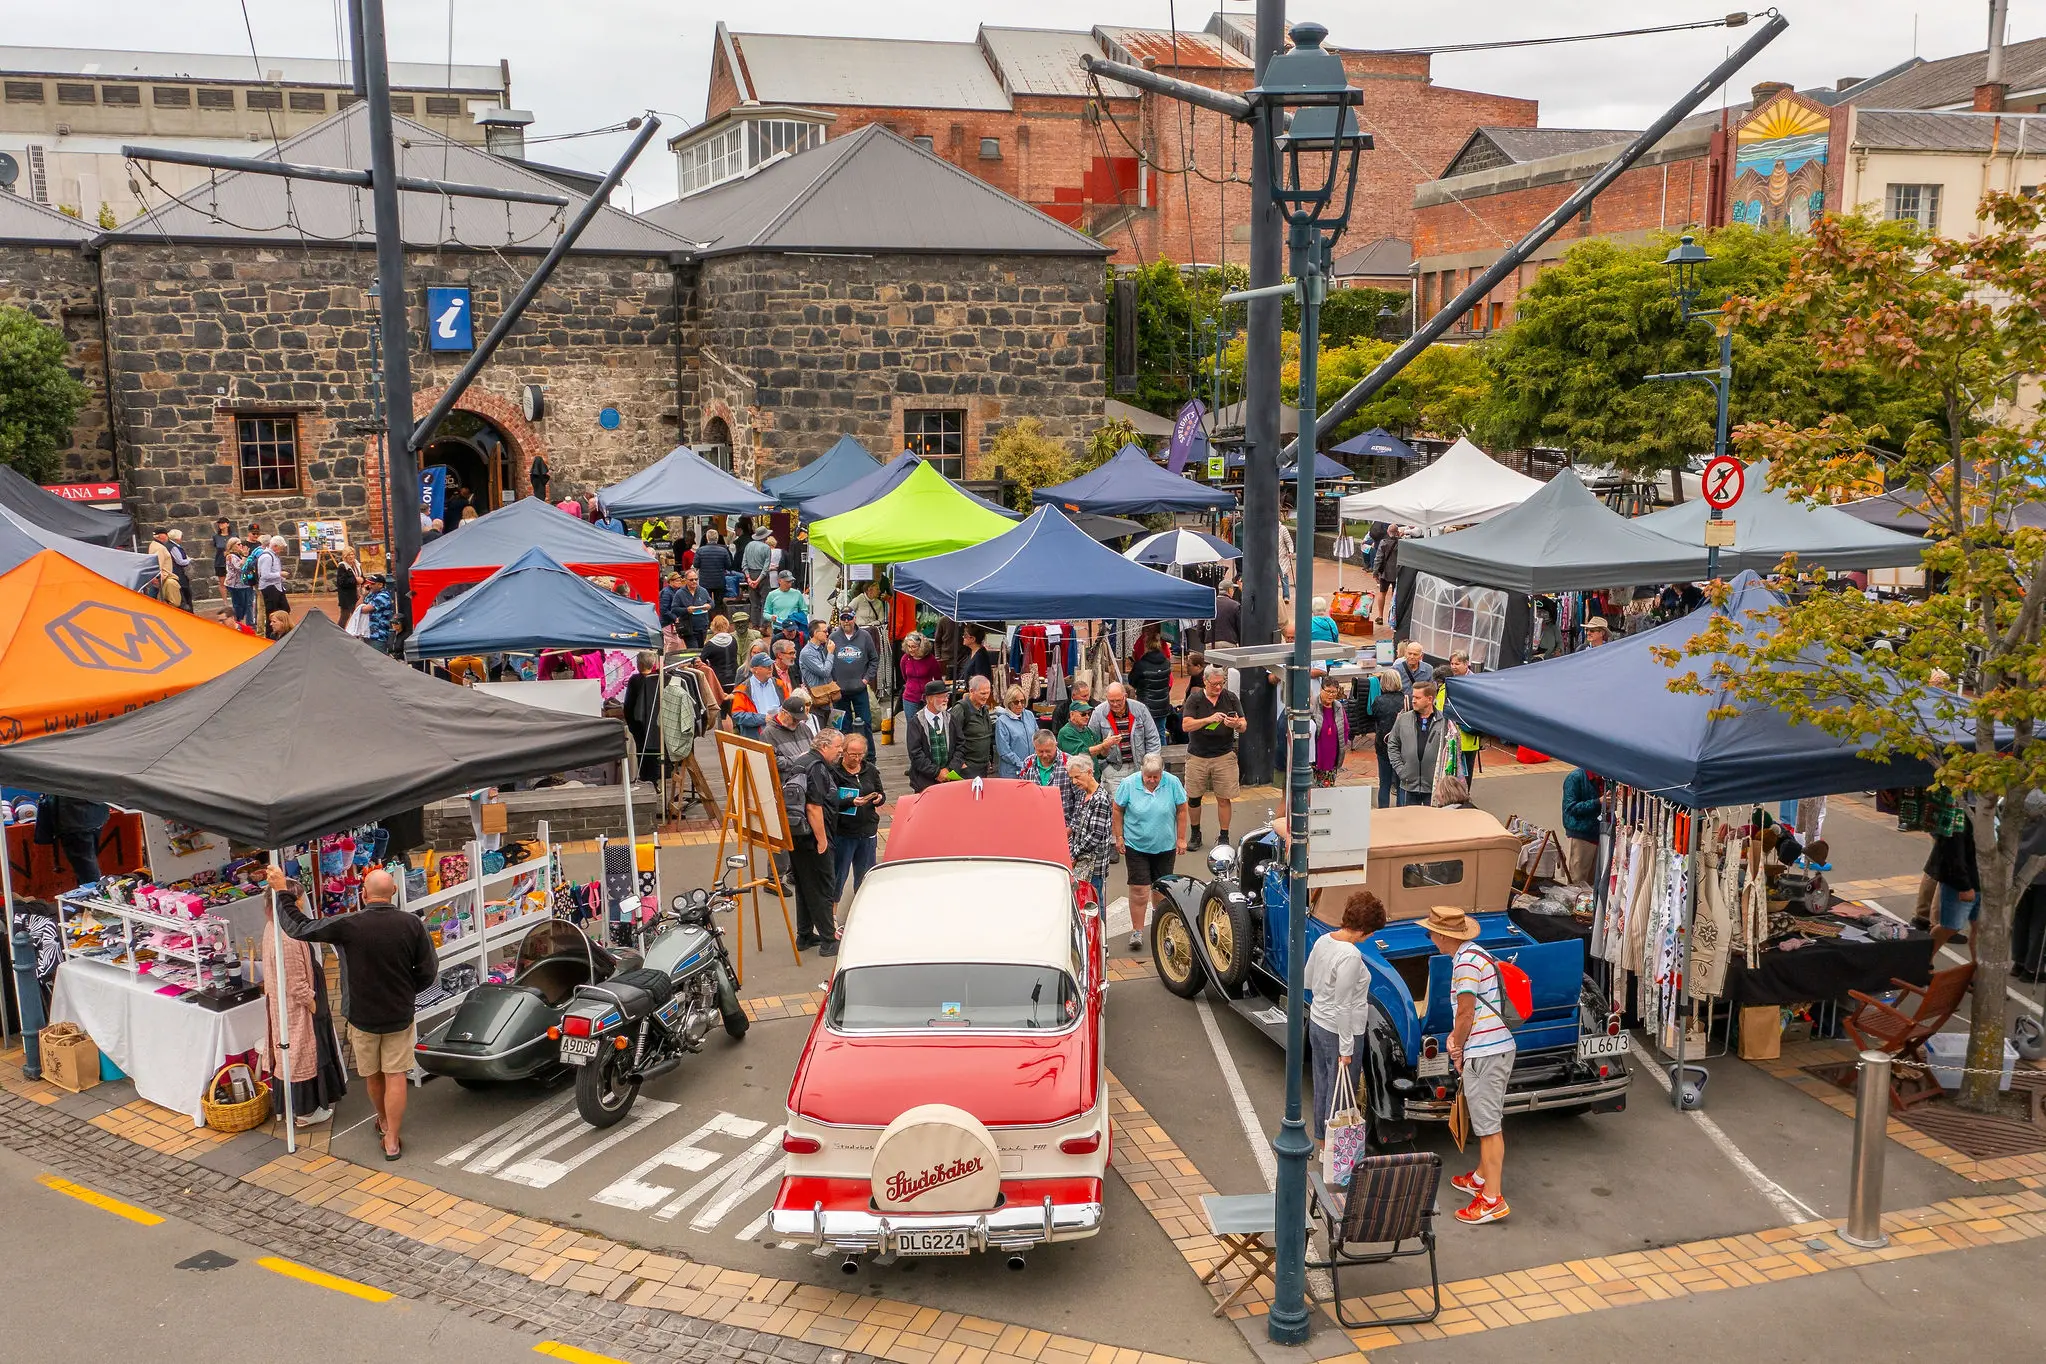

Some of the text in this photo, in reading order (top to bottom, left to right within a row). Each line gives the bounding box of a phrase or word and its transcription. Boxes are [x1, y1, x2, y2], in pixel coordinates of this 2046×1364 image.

[62, 486, 93, 499] ANA
[562, 1038, 596, 1055] A9DBC
[1581, 1034, 1628, 1056] YL6673
[886, 1156, 984, 1203] Studebaker
[899, 1234, 965, 1250] DLG224
